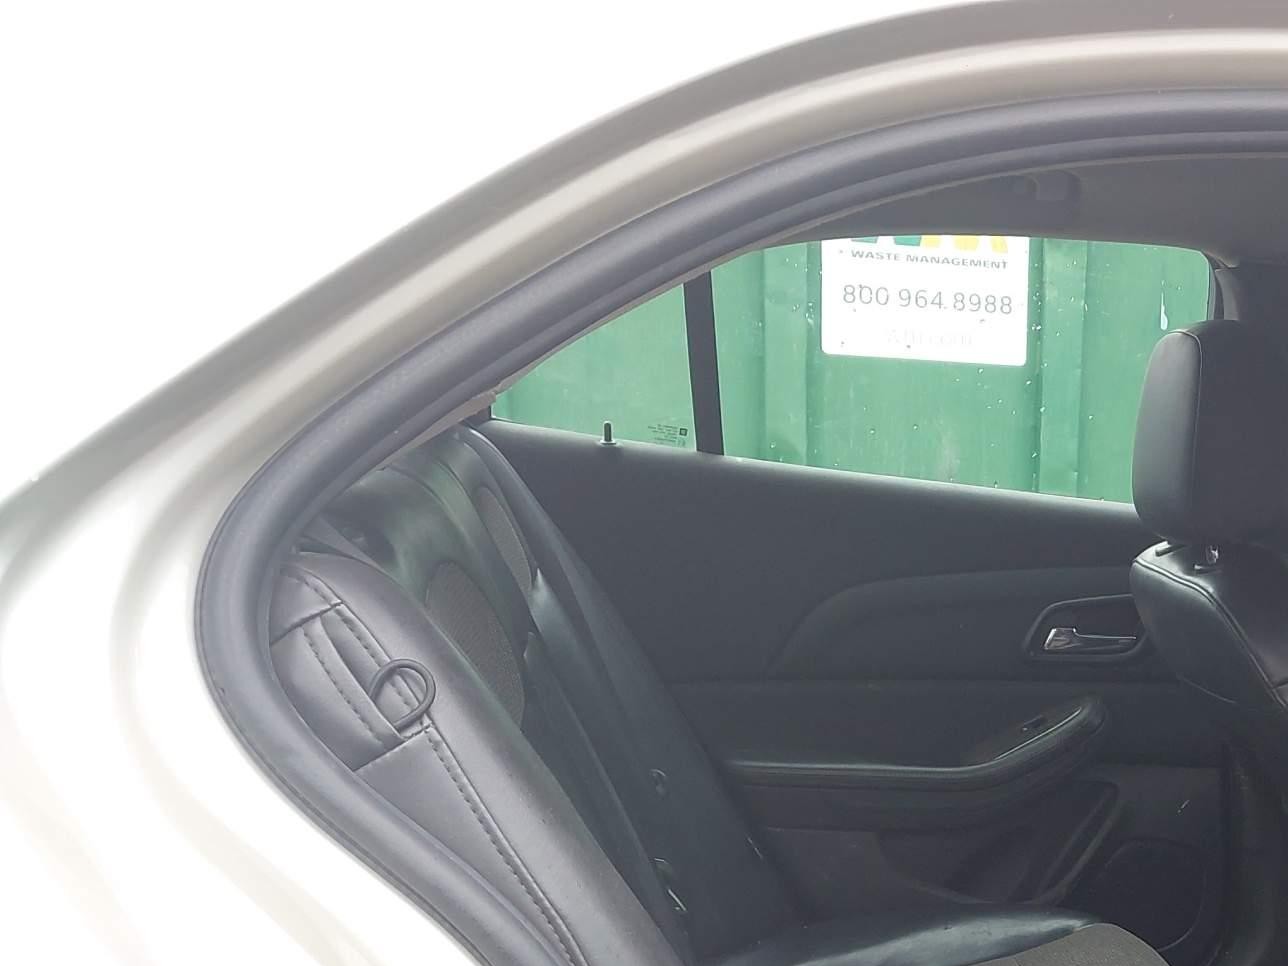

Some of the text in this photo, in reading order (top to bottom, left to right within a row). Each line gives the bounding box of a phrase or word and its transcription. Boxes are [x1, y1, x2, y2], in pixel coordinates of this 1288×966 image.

[851, 248, 1008, 269] WASTE MANAGEMENT
[842, 284, 1013, 315] 800 964.8988
